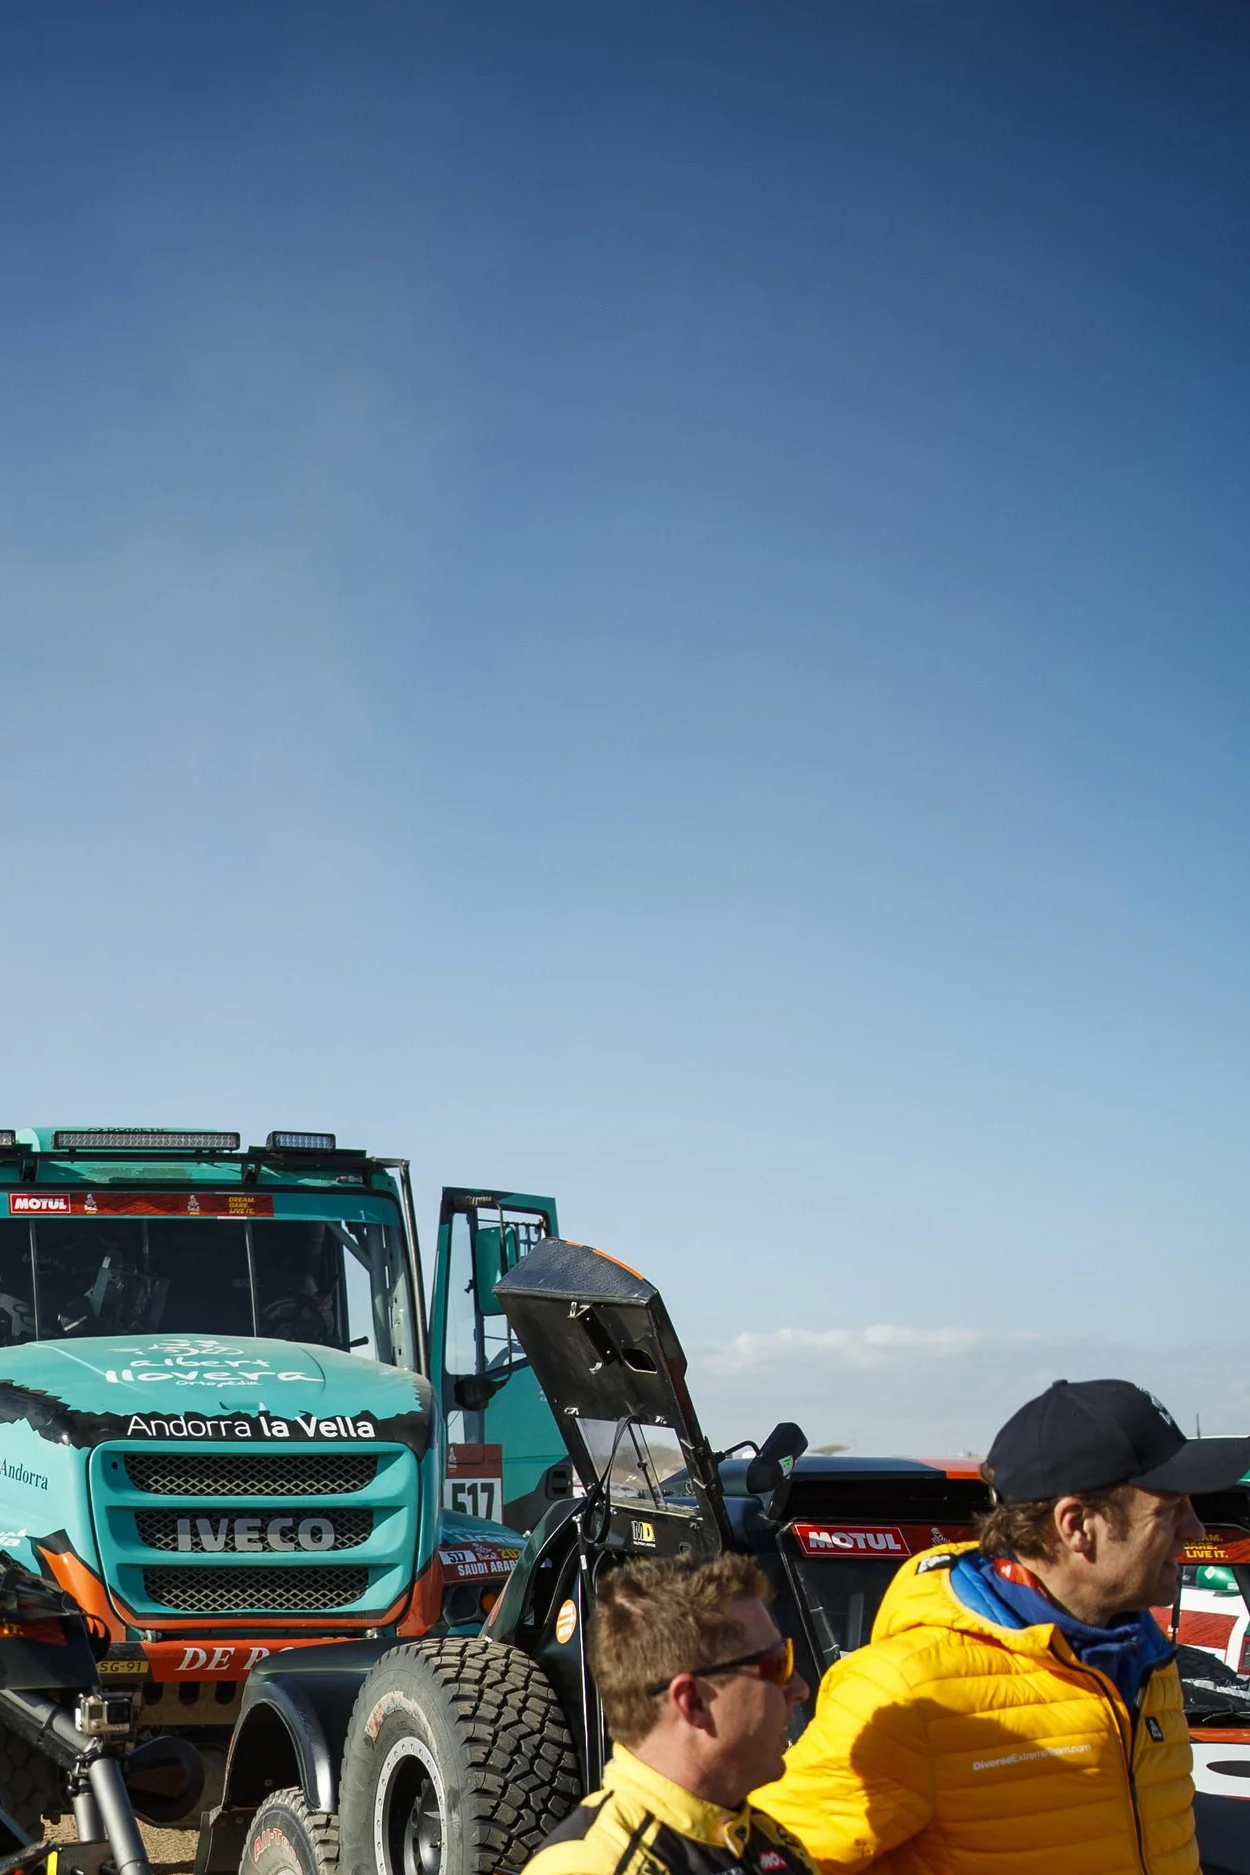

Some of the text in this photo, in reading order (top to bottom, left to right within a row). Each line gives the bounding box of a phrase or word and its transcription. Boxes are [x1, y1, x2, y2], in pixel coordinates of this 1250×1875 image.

[14, 1197, 67, 1210] MOTUL
[130, 1357, 271, 1368] albert
[105, 1369, 326, 1383] llovera
[127, 1415, 376, 1438] Andorra la Vella
[0, 1458, 48, 1491] Andorra
[452, 1482, 495, 1521] 517
[177, 1517, 335, 1553] IVECO
[808, 1531, 901, 1550] MOTUL
[447, 1551, 467, 1563] 517
[1186, 1550, 1229, 1558] LIVE IT.
[457, 1559, 518, 1577] SAUDI ARAB
[174, 1647, 235, 1671] DE
